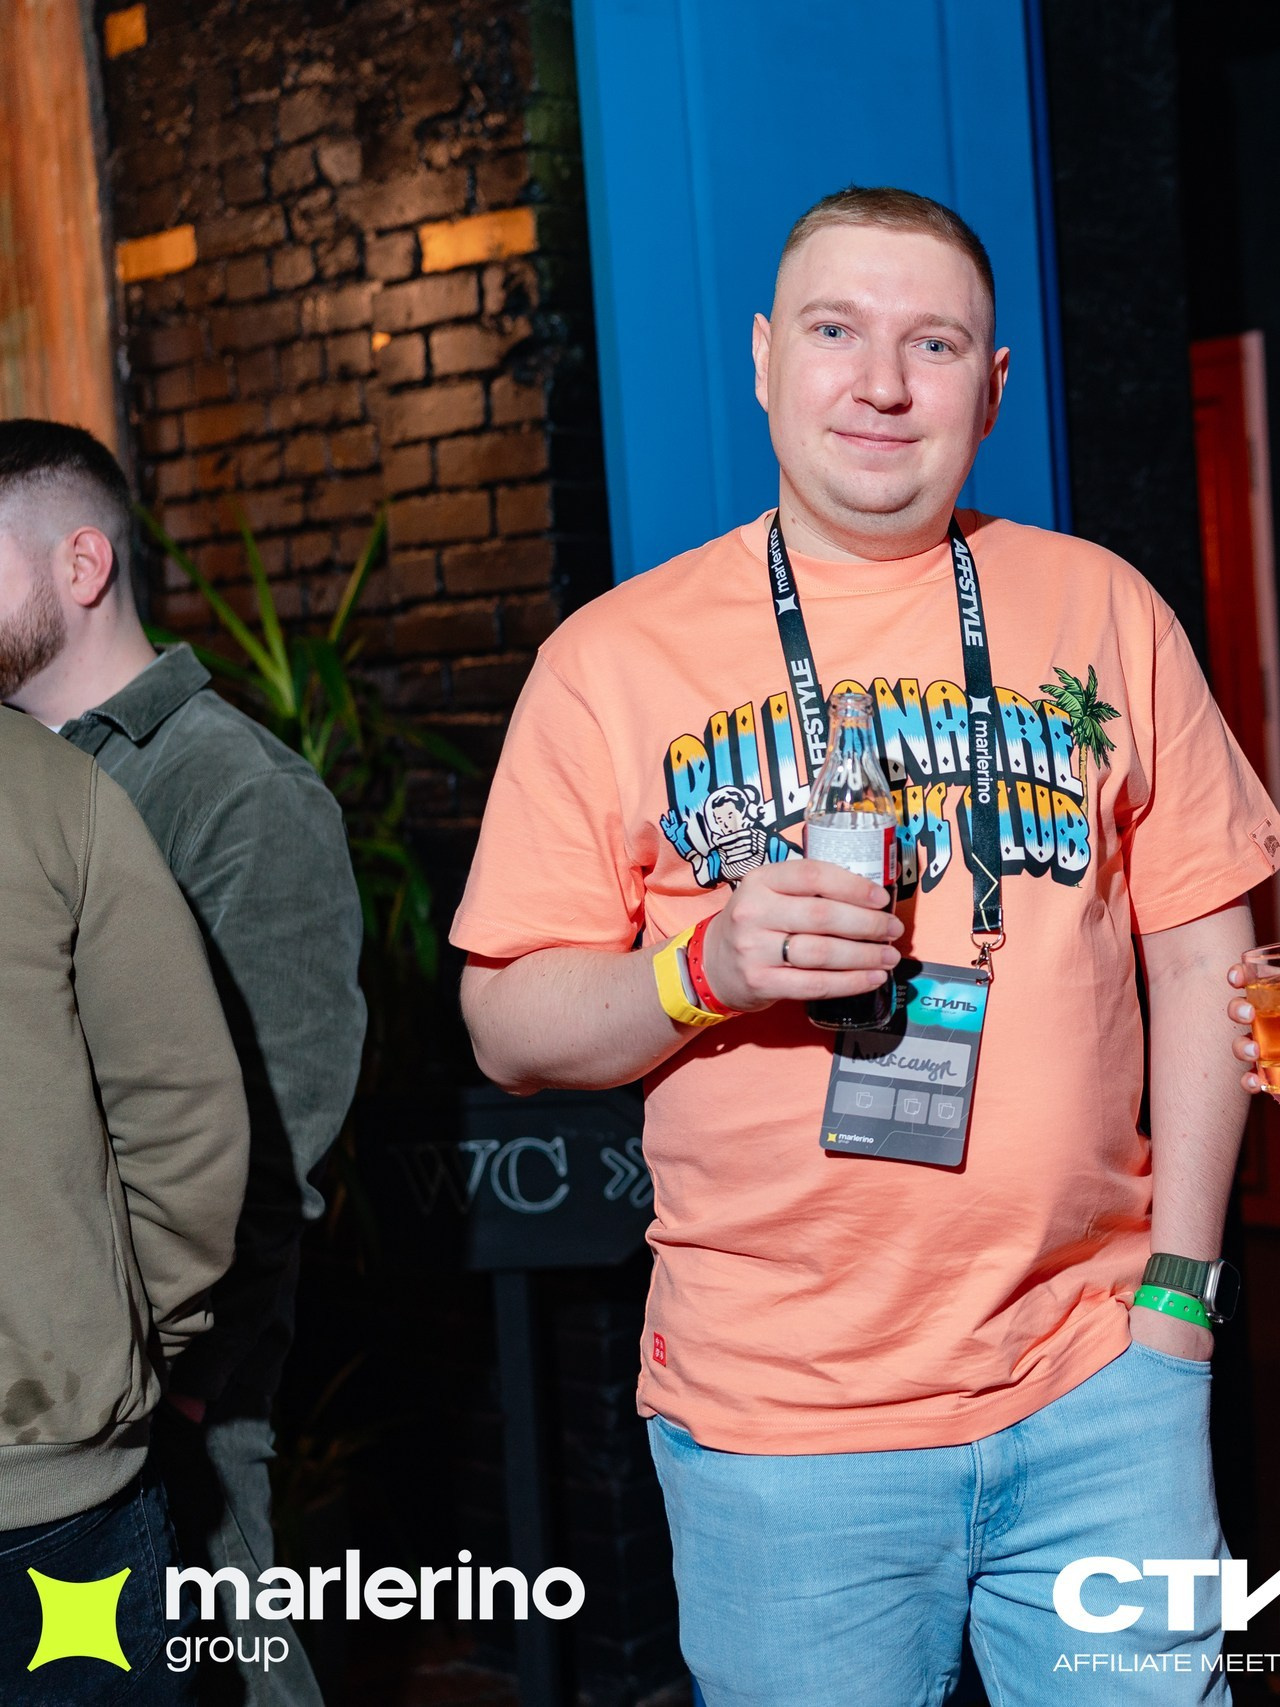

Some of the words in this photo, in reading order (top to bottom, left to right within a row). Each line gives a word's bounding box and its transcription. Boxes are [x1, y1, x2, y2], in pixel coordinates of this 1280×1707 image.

[767, 526, 791, 595] marlerino
[952, 536, 984, 648] AFFSTYLE
[974, 719, 993, 804] marlerino
[919, 995, 978, 1013] СТИЛЬ
